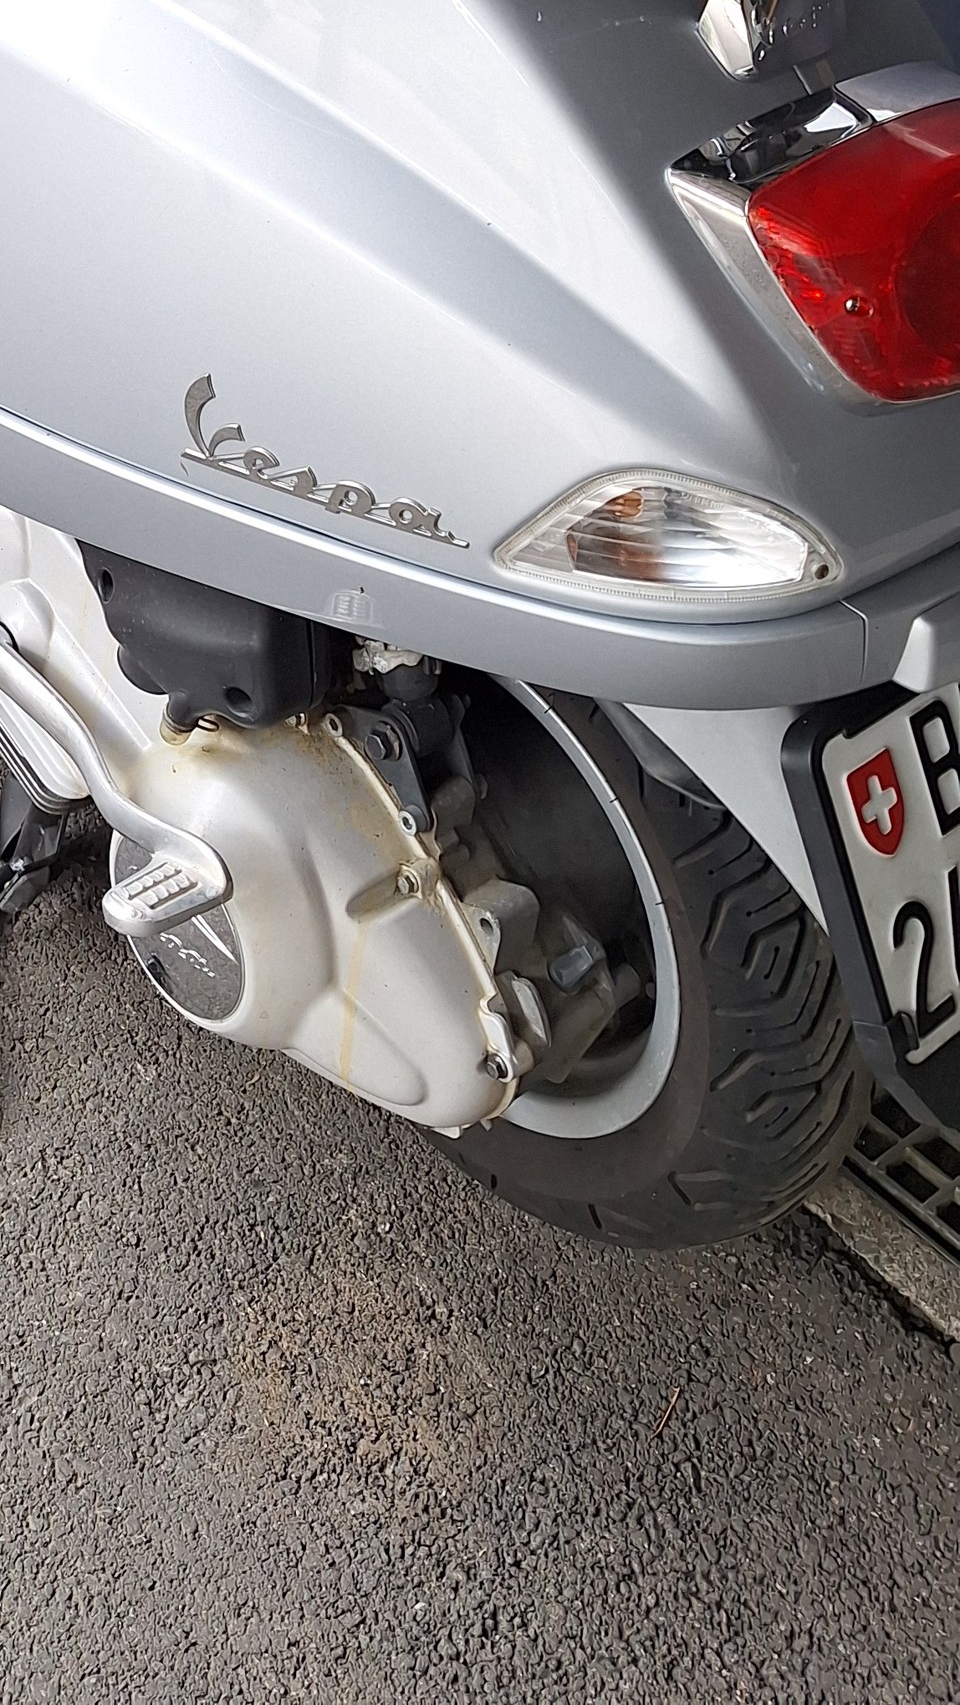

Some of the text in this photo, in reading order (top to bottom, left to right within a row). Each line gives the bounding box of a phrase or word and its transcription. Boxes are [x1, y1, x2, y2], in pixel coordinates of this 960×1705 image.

[180, 372, 470, 549] Vespa
[909, 689, 960, 837] B
[893, 866, 960, 1037] 2
